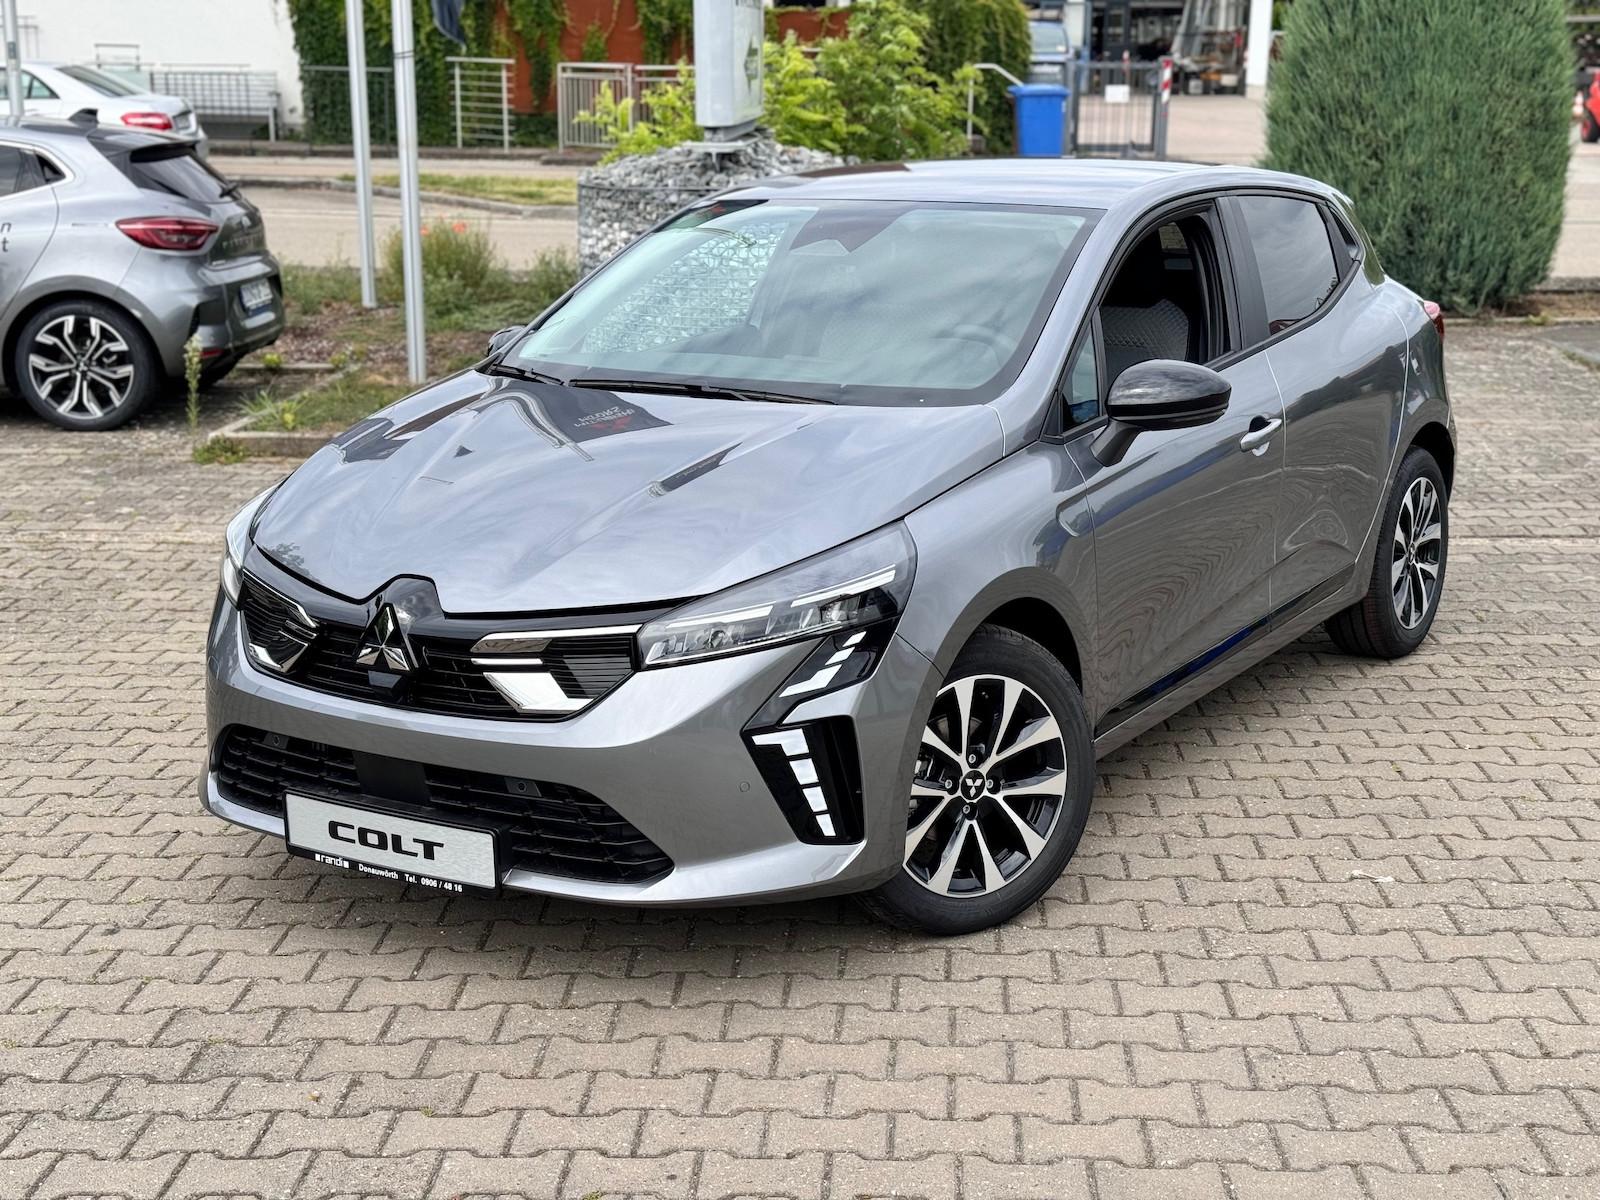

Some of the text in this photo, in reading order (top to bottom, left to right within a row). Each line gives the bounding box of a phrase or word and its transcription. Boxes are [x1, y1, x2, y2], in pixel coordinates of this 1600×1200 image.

[328, 820, 444, 860] COLT
[358, 863, 399, 880] Donauwörth
[404, 873, 418, 884] Tel.
[420, 877, 437, 888] 0906
[443, 881, 453, 891] 48
[453, 883, 463, 893] 16
